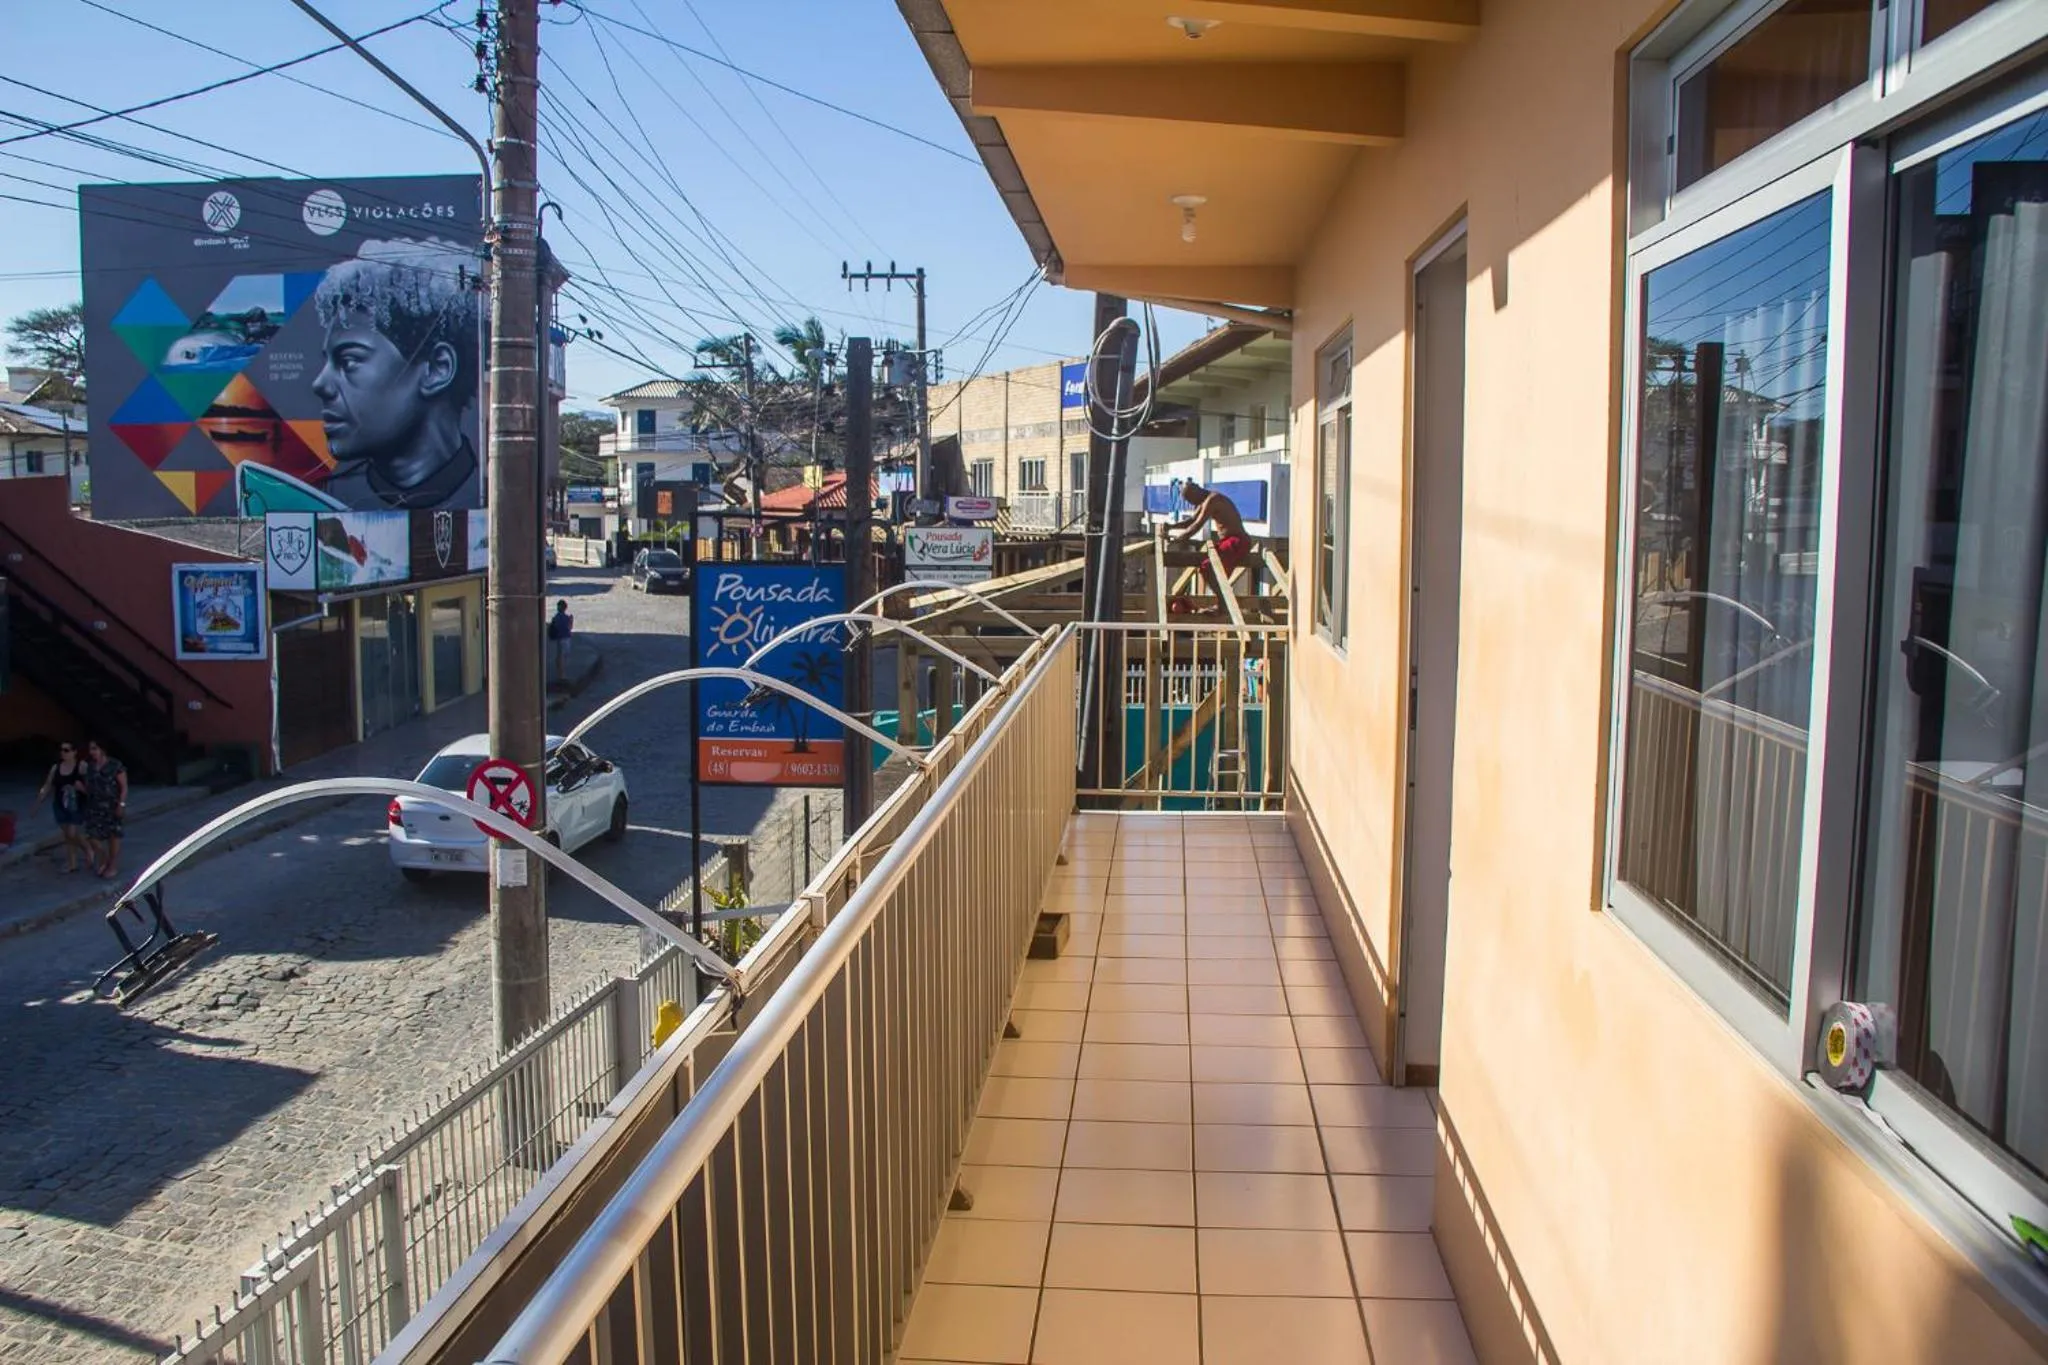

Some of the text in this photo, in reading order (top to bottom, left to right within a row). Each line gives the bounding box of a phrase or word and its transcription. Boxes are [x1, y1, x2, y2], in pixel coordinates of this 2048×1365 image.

[925, 542, 949, 553] Vera
[714, 572, 835, 604] Pousada
[706, 704, 758, 718] Guarda
[706, 720, 724, 733] do
